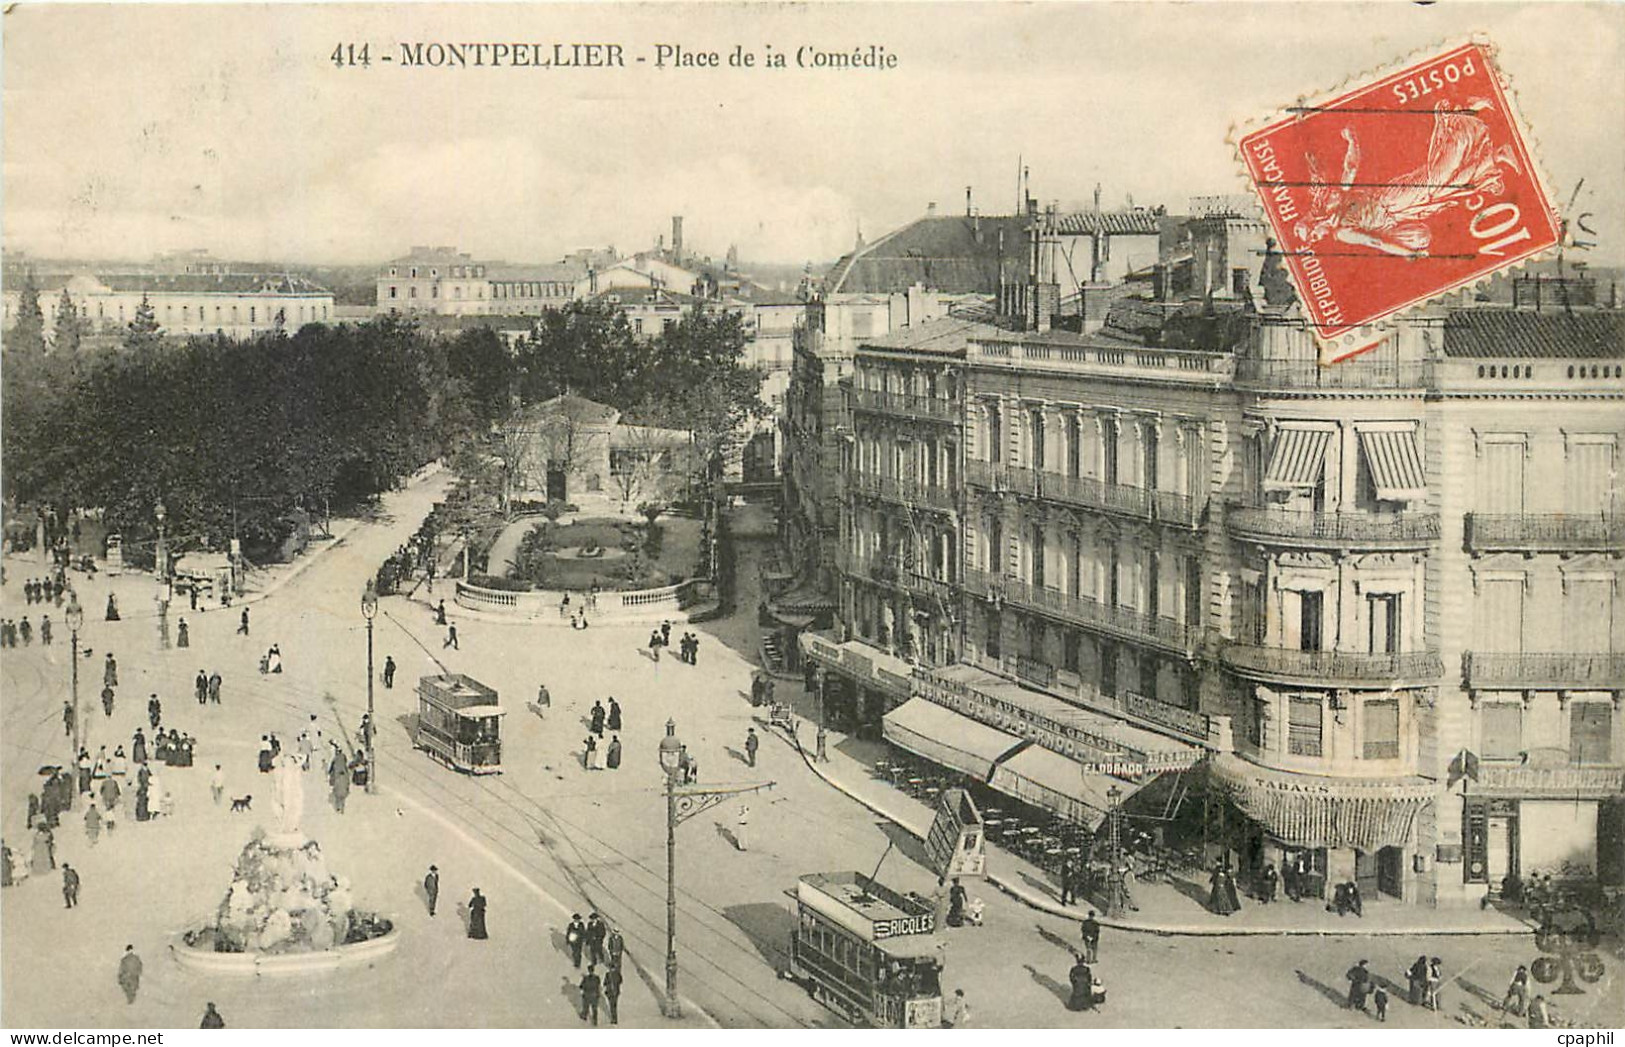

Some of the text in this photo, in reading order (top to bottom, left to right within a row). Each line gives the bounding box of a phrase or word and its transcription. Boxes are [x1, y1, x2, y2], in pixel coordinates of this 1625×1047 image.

[1392, 56, 1476, 104] POSTES
[1084, 763, 1143, 776] ELDORADO
[1255, 778, 1330, 794] TABACS
